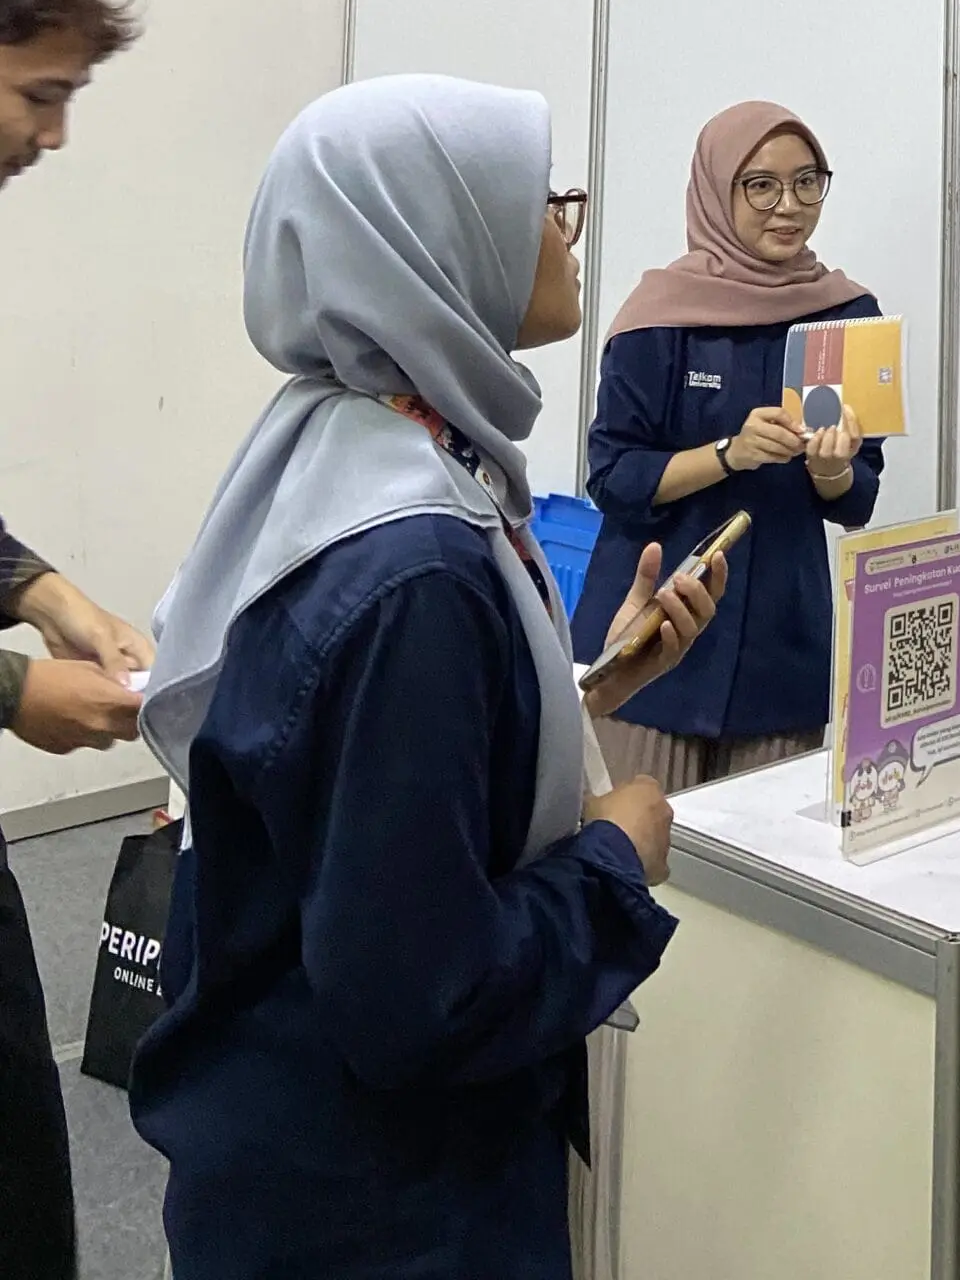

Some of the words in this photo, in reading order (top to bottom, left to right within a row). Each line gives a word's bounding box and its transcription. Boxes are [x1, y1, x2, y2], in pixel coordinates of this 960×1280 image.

[687, 370, 722, 383] Telkom
[864, 578, 892, 595] Survei
[894, 567, 947, 588] Peningkatan
[99, 921, 163, 971] PERIP
[113, 966, 155, 993] ONLINE
